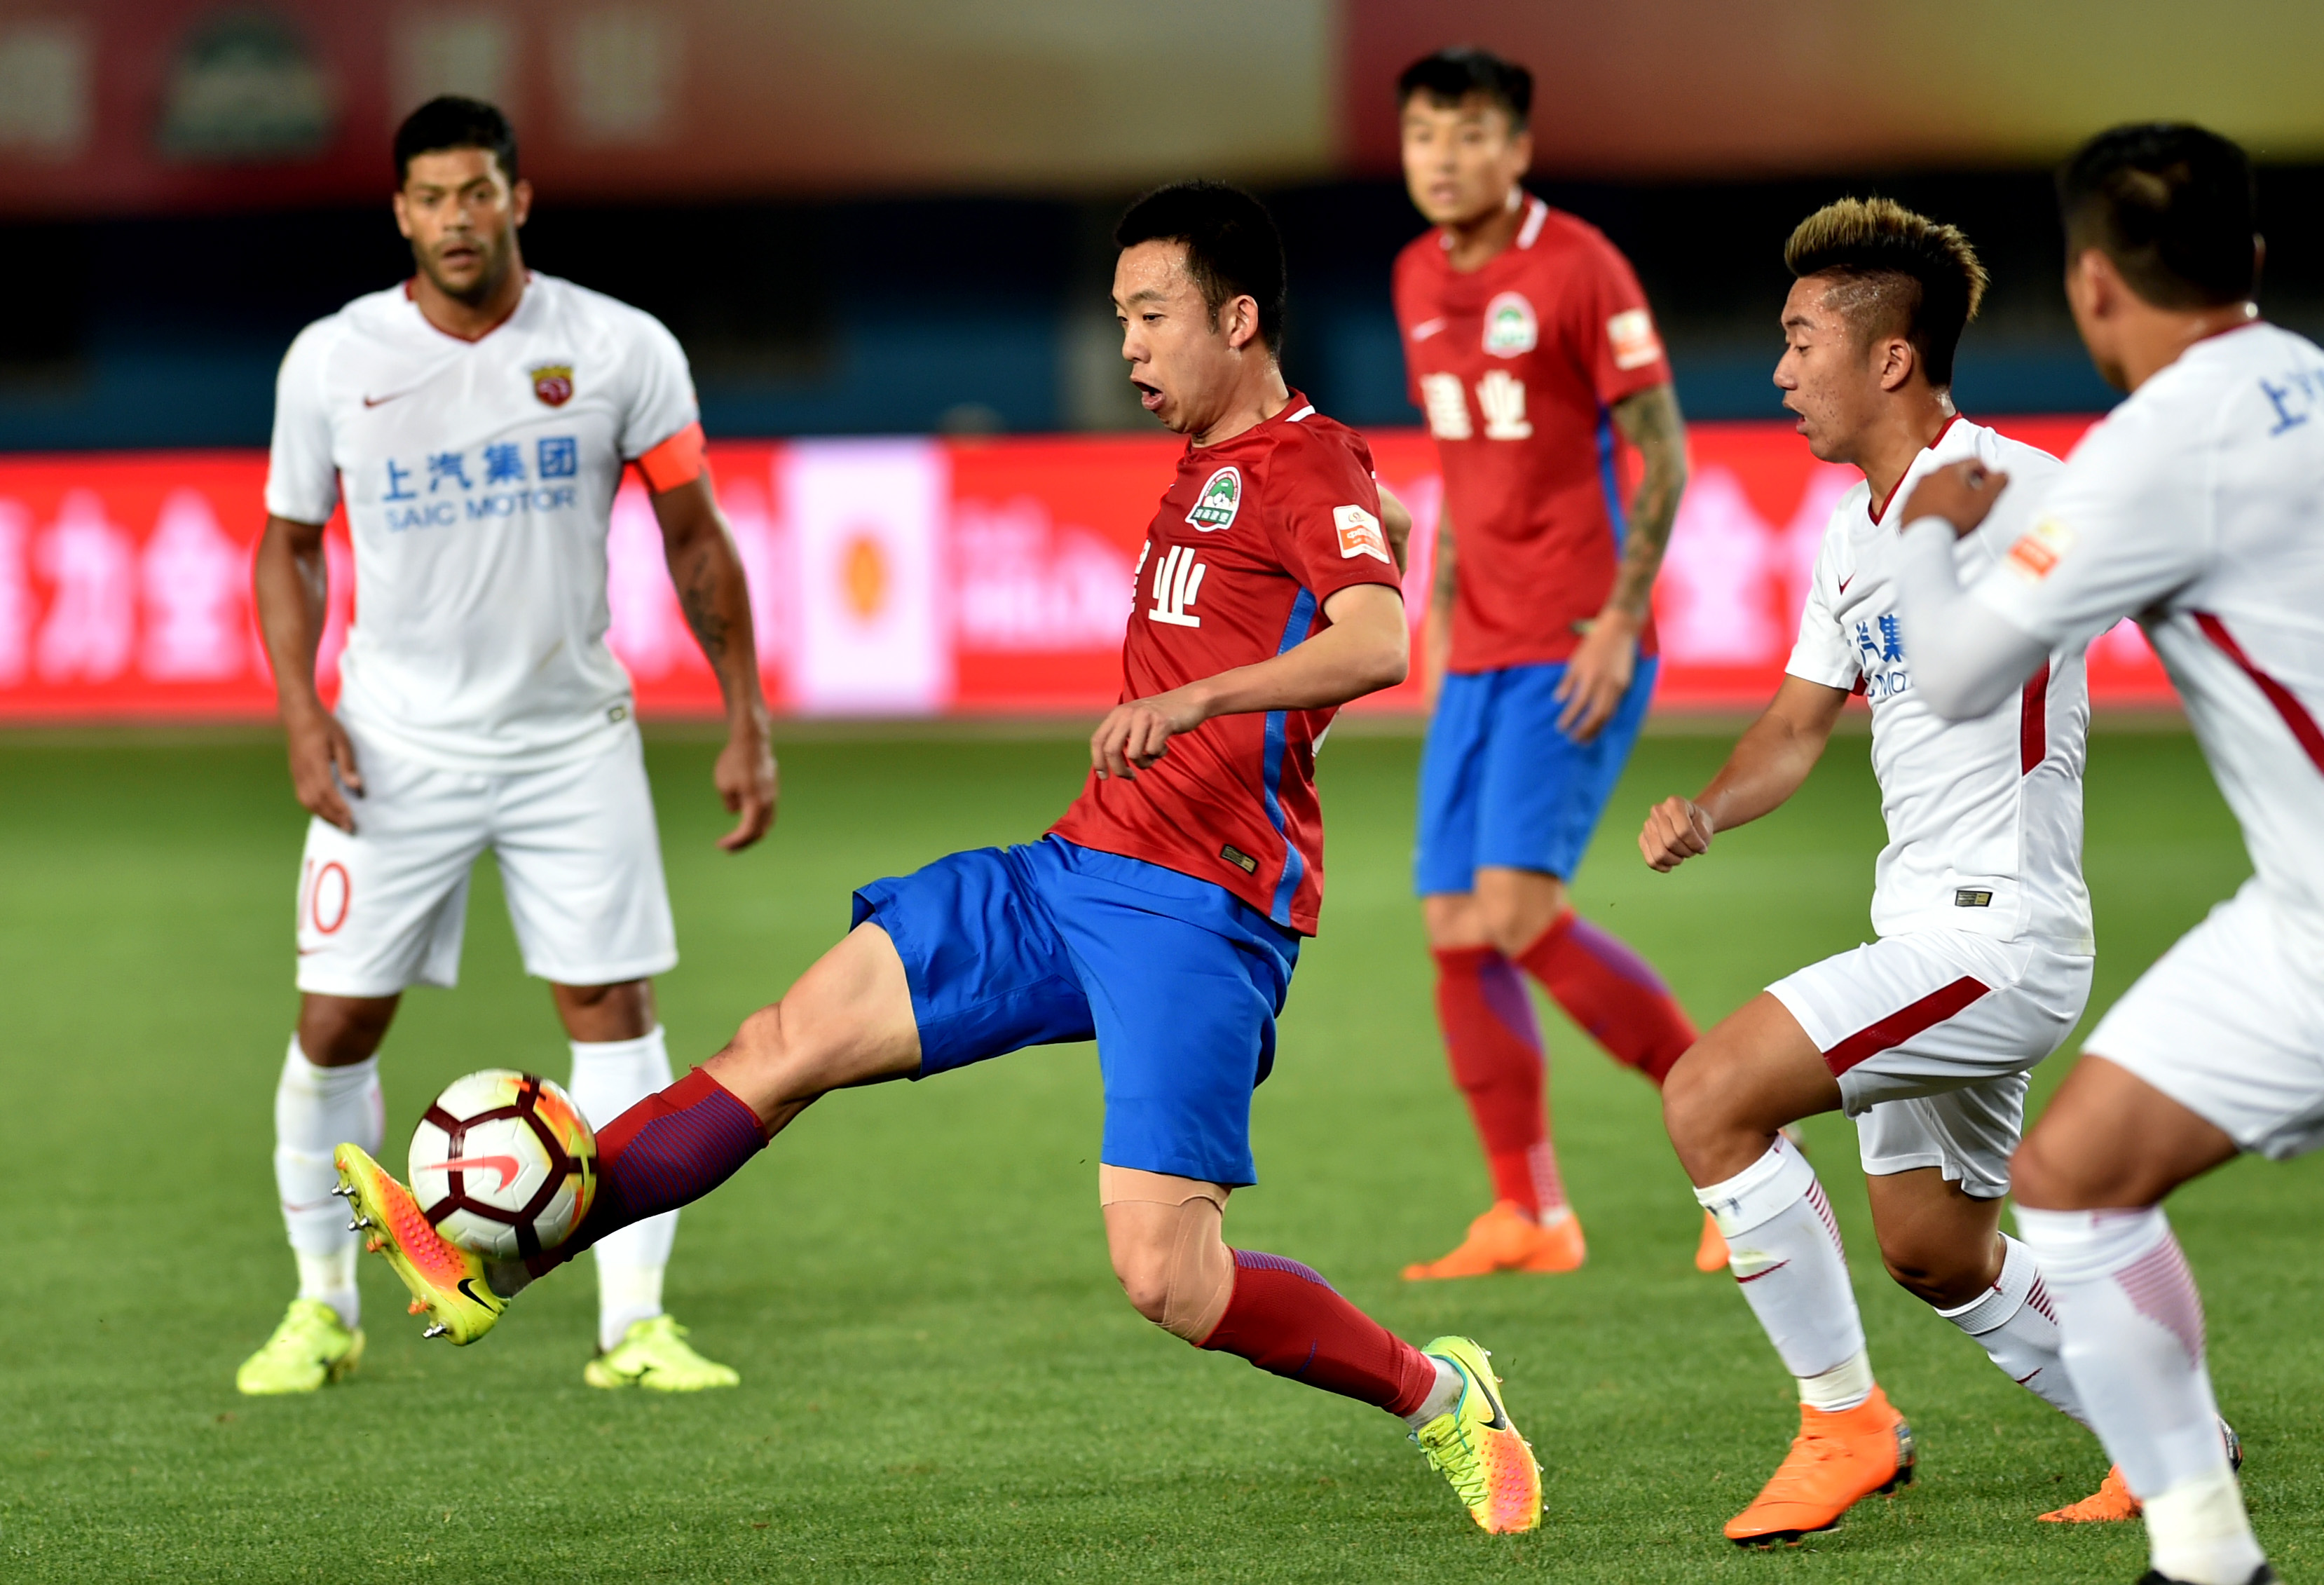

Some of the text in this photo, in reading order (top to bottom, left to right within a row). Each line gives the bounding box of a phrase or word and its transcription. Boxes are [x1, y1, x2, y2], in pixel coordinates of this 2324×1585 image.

[383, 437, 576, 501] 上汽集团
[385, 487, 576, 531] SAIC MOTOR
[1132, 539, 1206, 628] 业
